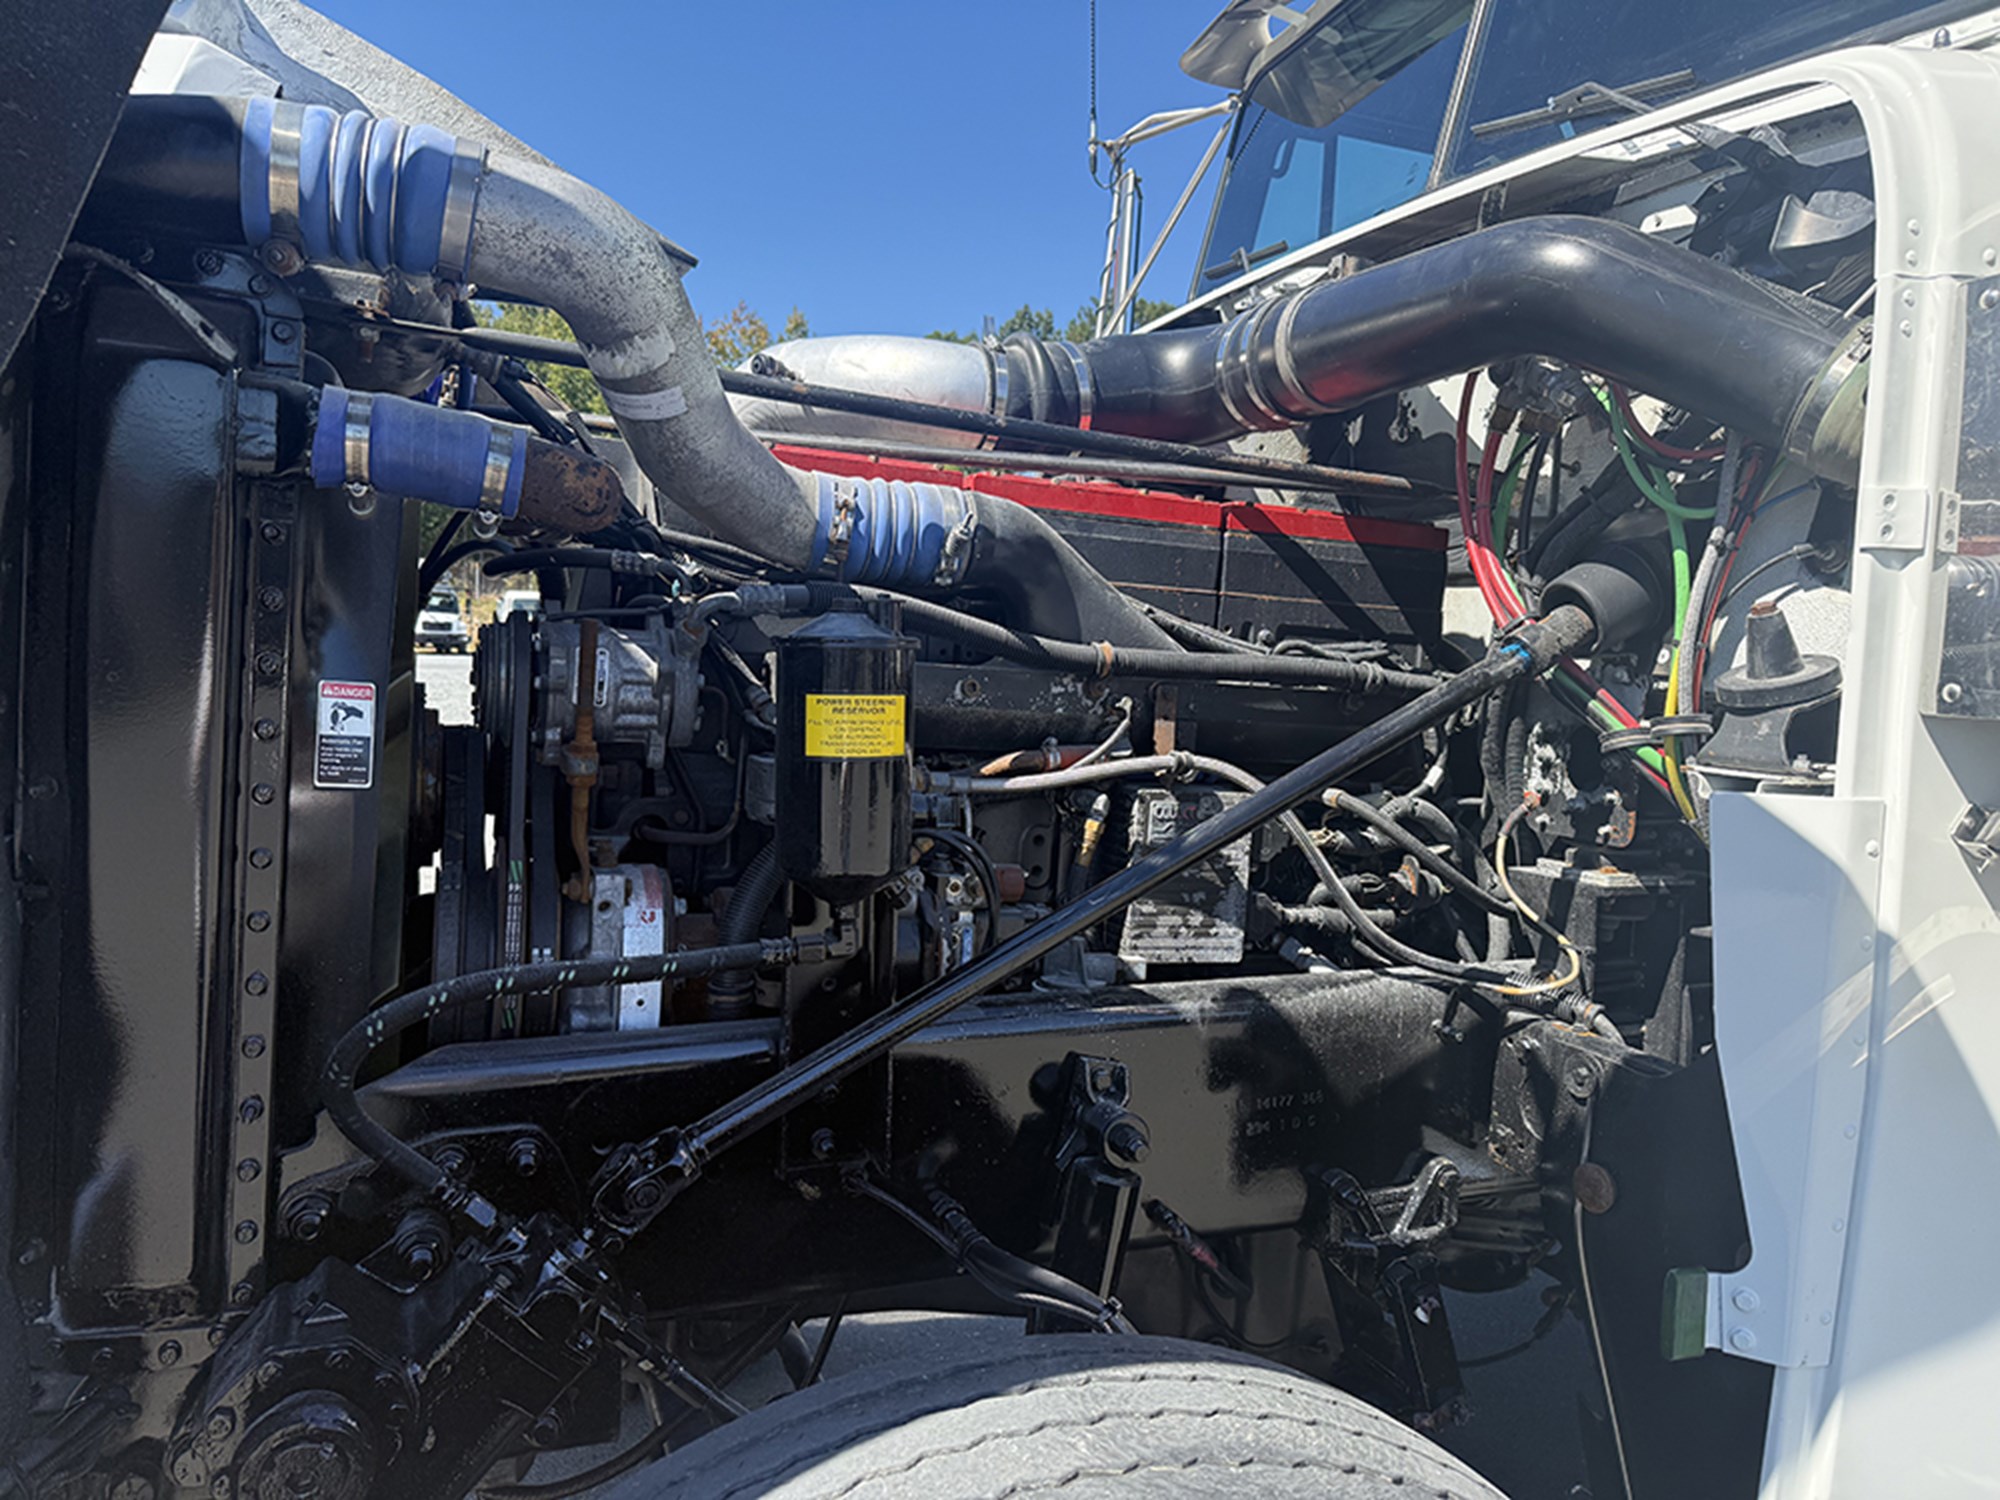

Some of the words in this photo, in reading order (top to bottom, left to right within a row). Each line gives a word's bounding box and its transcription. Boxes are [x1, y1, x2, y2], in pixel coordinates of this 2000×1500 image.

[333, 686, 373, 698] DANGER
[816, 698, 852, 706] POWER
[854, 698, 897, 706] STEERING
